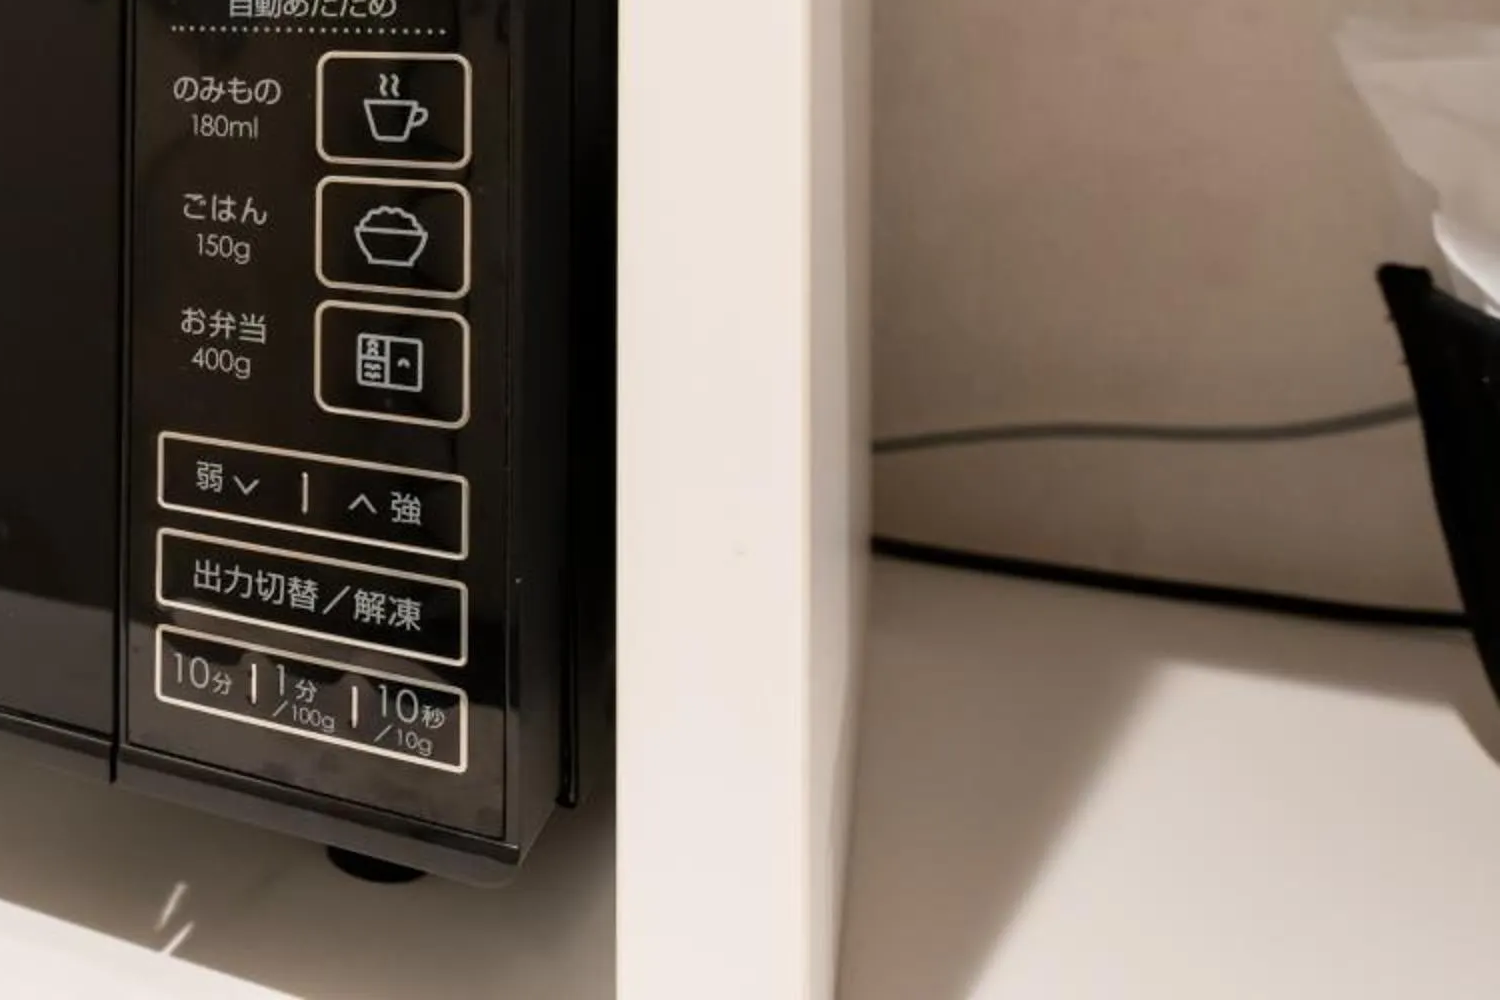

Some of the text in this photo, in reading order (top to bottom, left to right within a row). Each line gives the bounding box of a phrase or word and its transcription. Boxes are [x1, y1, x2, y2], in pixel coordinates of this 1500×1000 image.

[172, 75, 282, 105] のみもの
[191, 113, 259, 139] 180ml
[183, 193, 268, 226] ごはん
[196, 233, 251, 265] 150g
[180, 307, 267, 345] お弁当
[191, 346, 251, 380] 400g
[196, 460, 421, 526] 弱 強
[172, 652, 446, 730] 10分 1分 10秒
